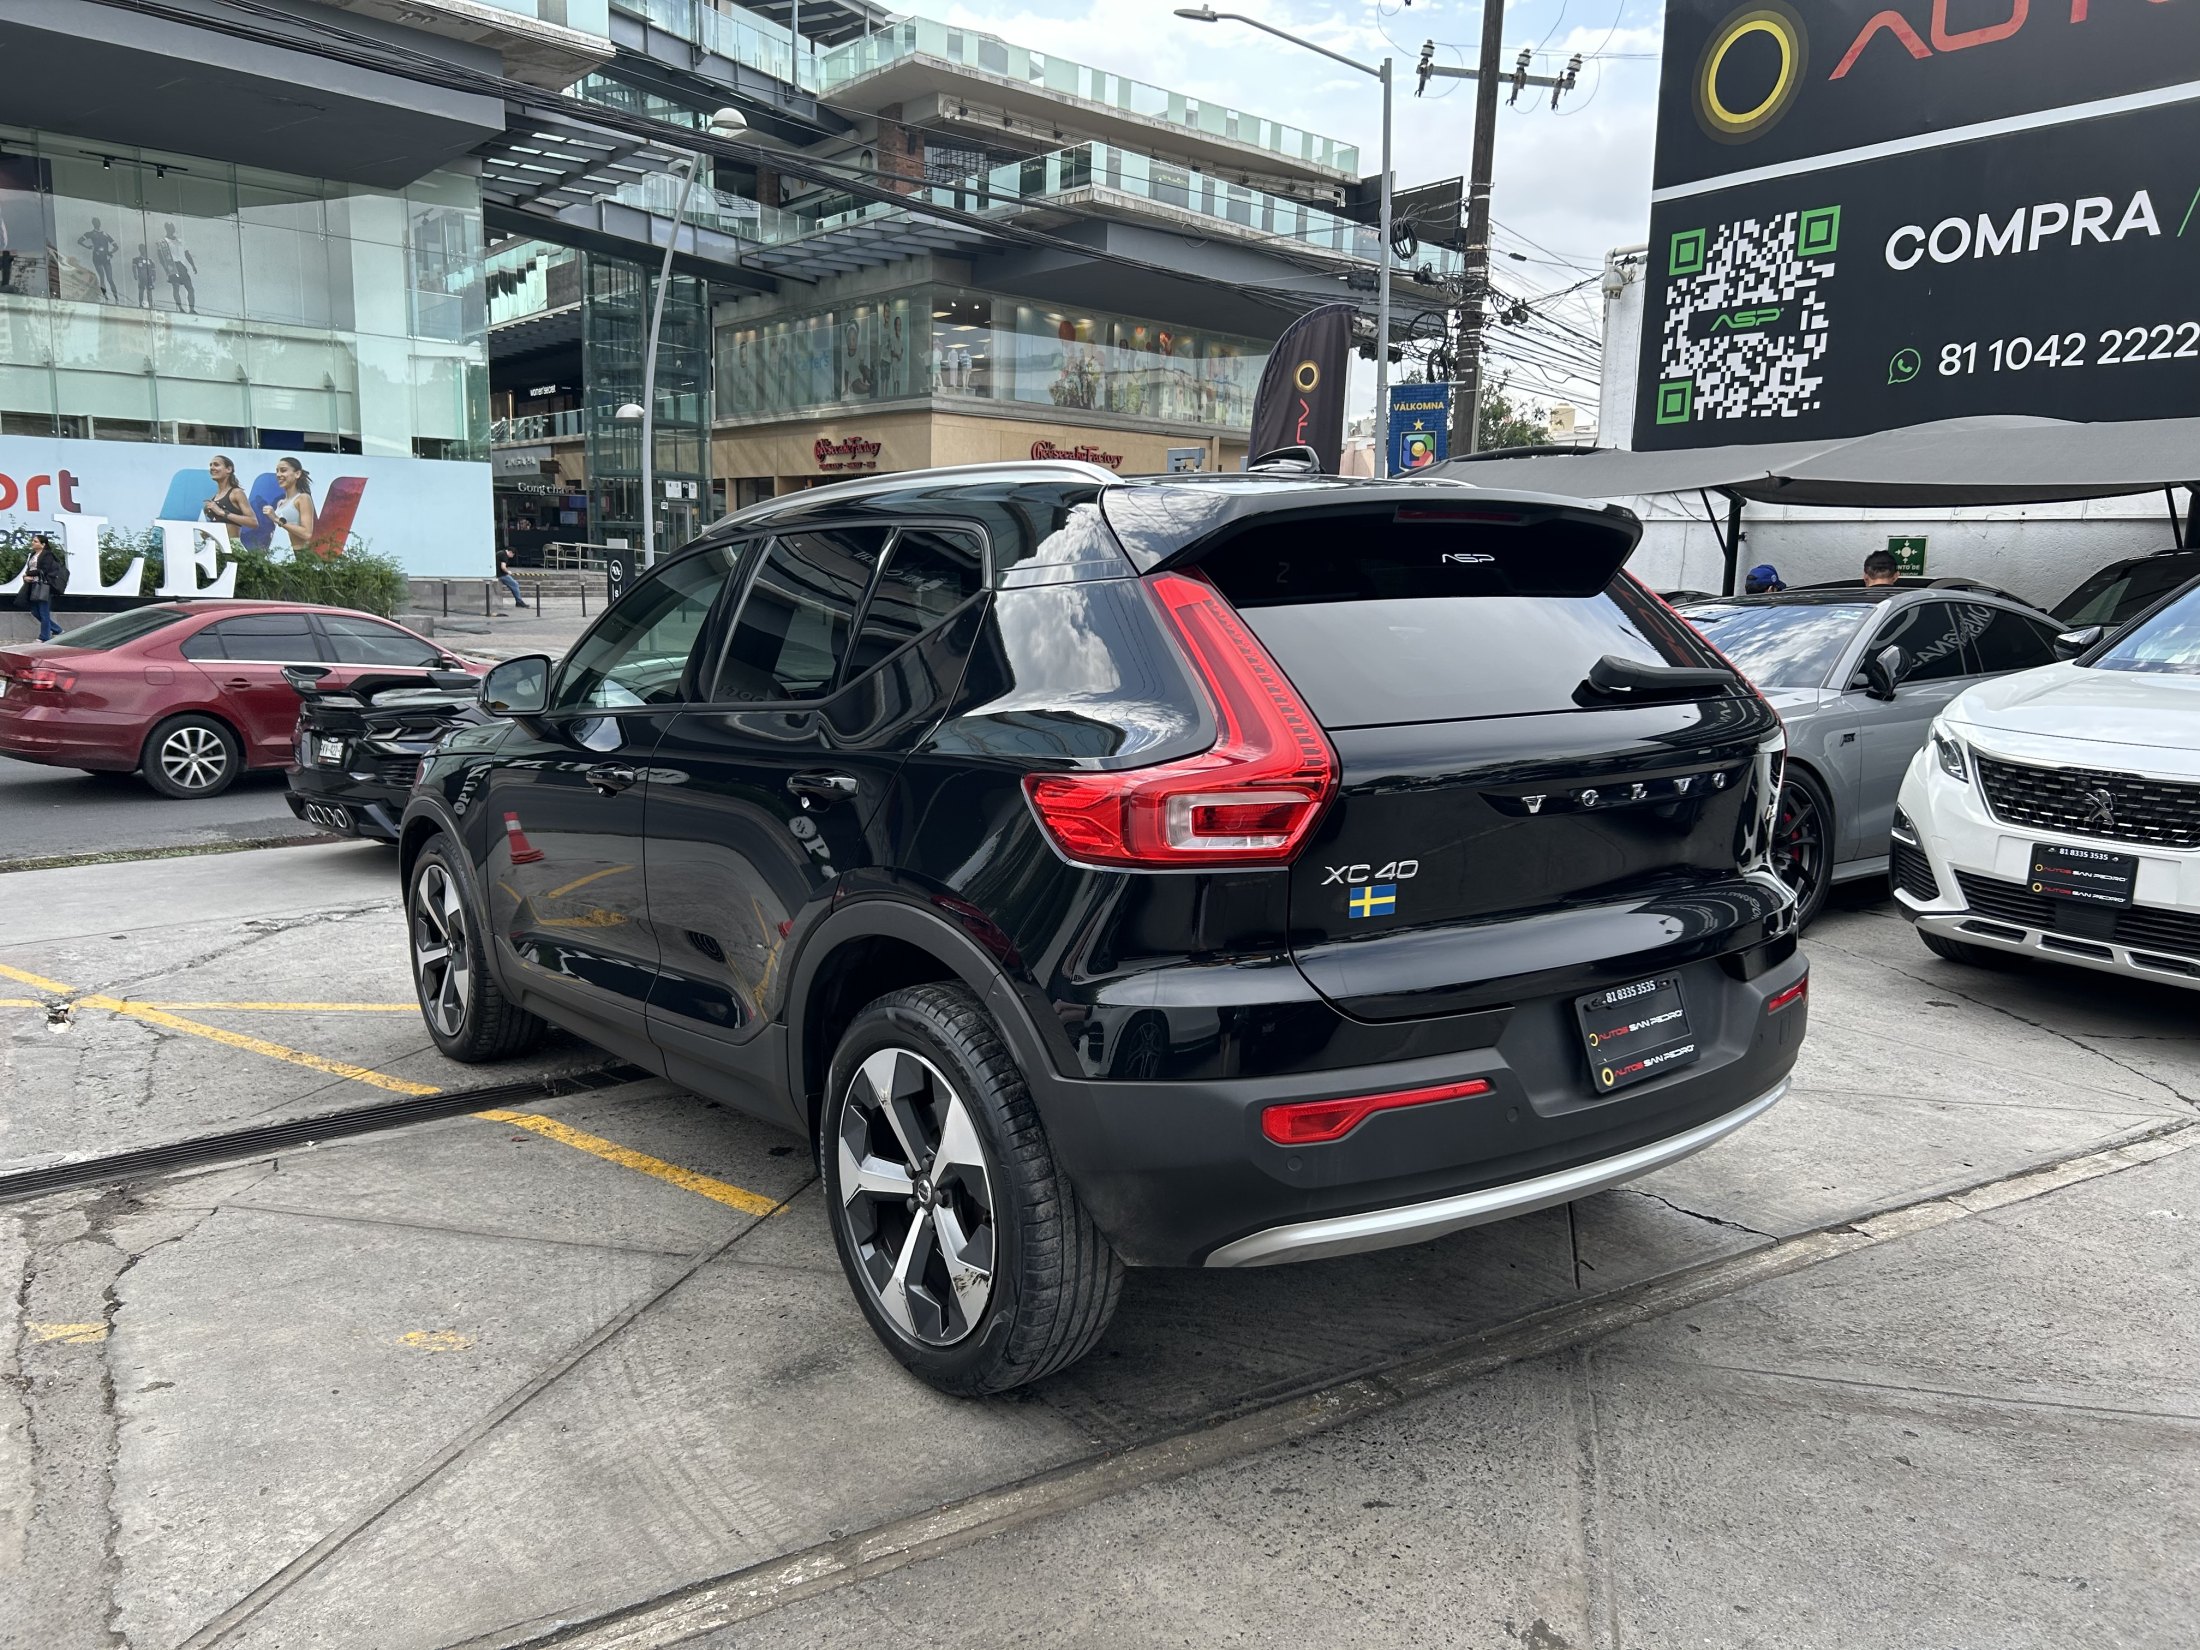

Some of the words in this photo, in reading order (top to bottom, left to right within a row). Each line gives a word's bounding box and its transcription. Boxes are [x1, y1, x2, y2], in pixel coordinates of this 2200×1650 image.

[1885, 190, 2161, 271] COMPRA
[1938, 342, 1977, 376] 81
[1988, 332, 2086, 372] 1042
[2097, 321, 2200, 365] 2222
[1393, 401, 1445, 411] VÄLKOMNA
[1081, 445, 1124, 469] Factory
[518, 482, 546, 496] Gong
[1521, 772, 1727, 814] VOLVO
[2069, 849, 2088, 858] 8335
[2090, 851, 2108, 861] 3535
[2043, 866, 2072, 874] AUTOS
[2072, 870, 2092, 878] SAN
[2093, 873, 2127, 882] PEDRO
[2043, 886, 2072, 895] AUTOS
[2072, 890, 2092, 898] SAN
[2092, 894, 2126, 903] PEDRO
[1605, 991, 1617, 1003] 81
[1617, 986, 1636, 1000] 8335
[1636, 980, 1656, 995] 3535
[1598, 1026, 1629, 1041] AUTOS
[1629, 1020, 1650, 1032] SAN
[1650, 1009, 1683, 1025] PEDRO
[1614, 1061, 1644, 1077] AUTOS
[1644, 1055, 1664, 1067] SAN
[1663, 1044, 1694, 1060] PEDRO
